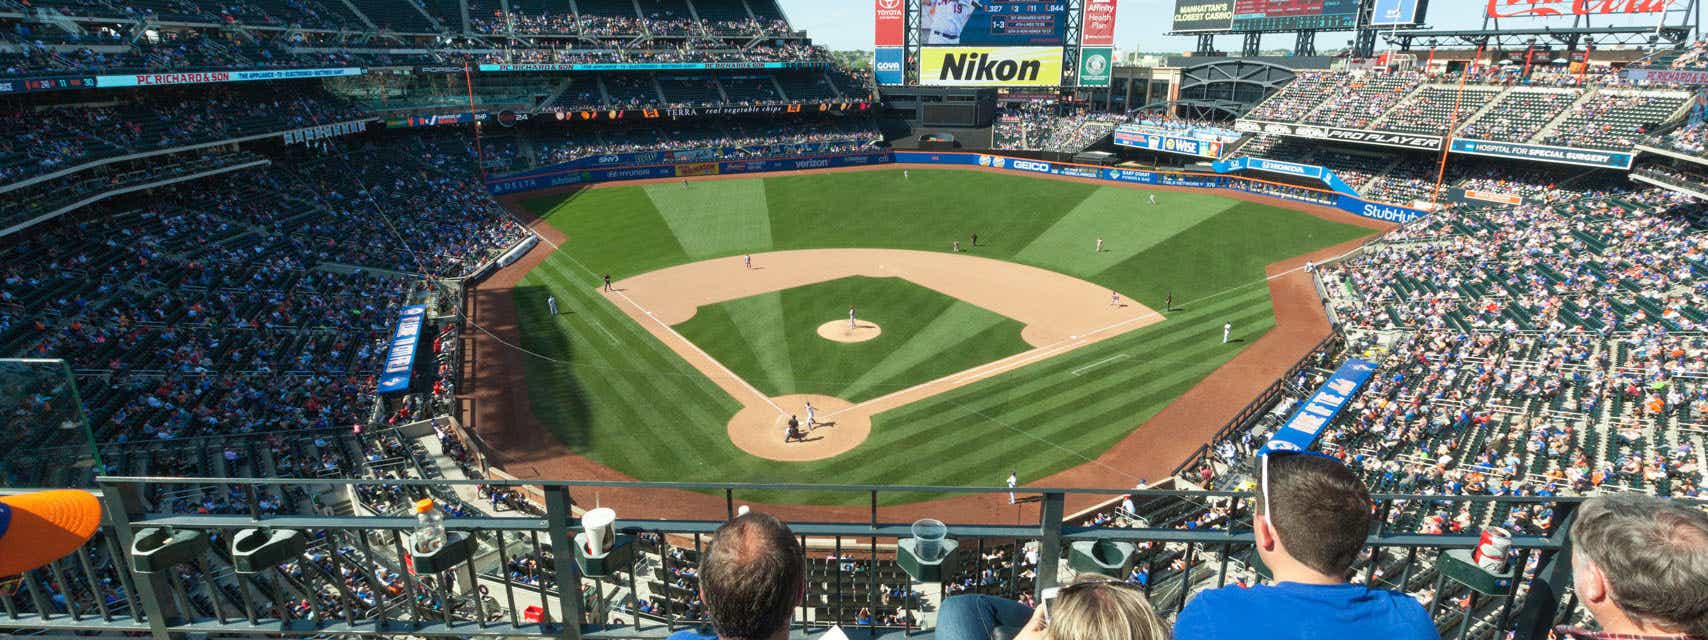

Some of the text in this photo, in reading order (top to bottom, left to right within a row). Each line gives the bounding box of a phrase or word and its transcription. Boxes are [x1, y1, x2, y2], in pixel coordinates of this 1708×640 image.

[1088, 5, 1114, 13] Affinity
[1180, 4, 1228, 14] MANHATTAN'S
[1175, 12, 1232, 21] CLOSEST CASINO
[940, 52, 1041, 81] Nikon
[136, 72, 229, 85] PC RICHARD & SON
[667, 108, 697, 116] TERRA
[705, 106, 720, 114] real
[724, 106, 759, 115] vegetable
[1328, 130, 1364, 140] PRO
[1364, 134, 1439, 147] PLAYER
[1175, 139, 1197, 153] WISE
[1475, 144, 1511, 154] HOSPITAL
[1528, 149, 1564, 159] SPECIAL
[1566, 152, 1610, 162] SURGERY
[795, 159, 828, 168] verizon
[1013, 160, 1049, 172] GEICO
[1269, 163, 1304, 173] HONDA
[1363, 204, 1419, 223] StubHub
